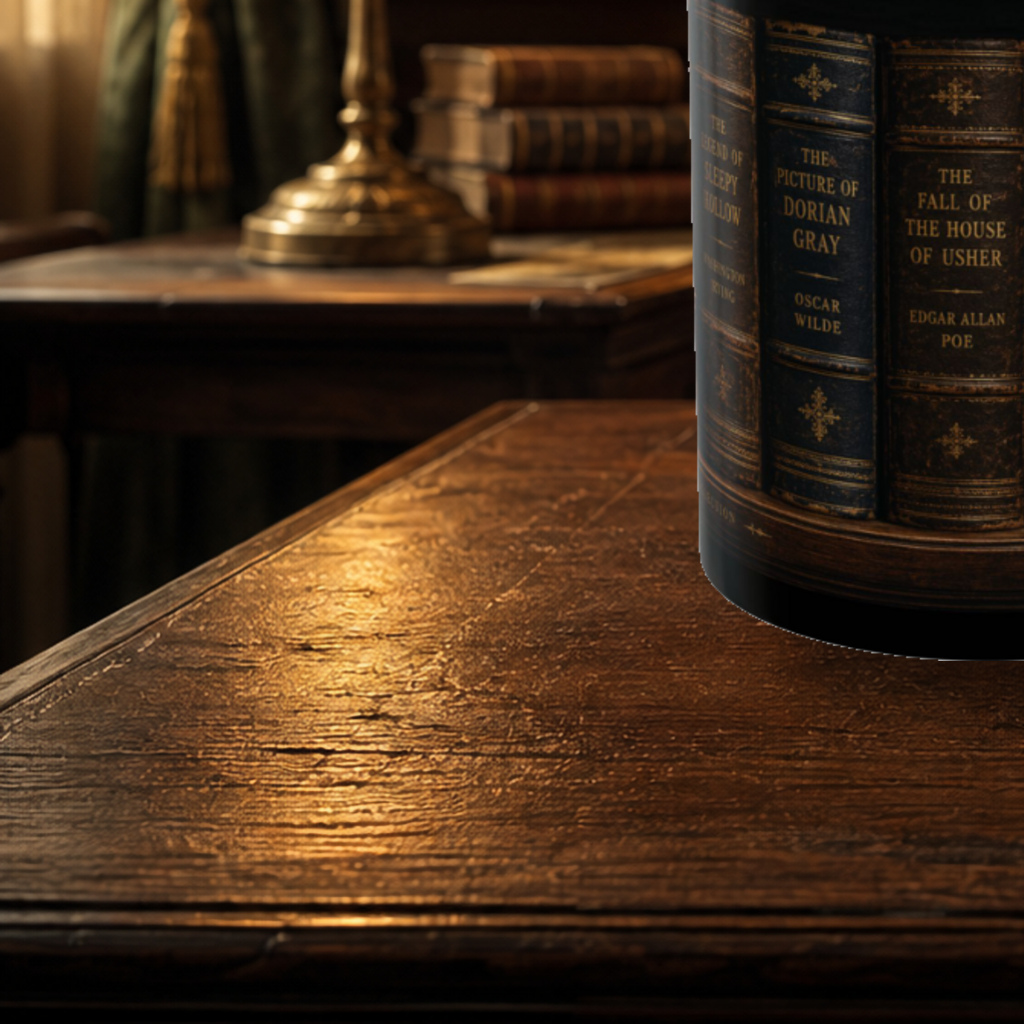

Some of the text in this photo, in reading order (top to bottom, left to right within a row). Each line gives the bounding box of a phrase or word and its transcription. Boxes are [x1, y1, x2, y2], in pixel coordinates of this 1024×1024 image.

[711, 114, 727, 135] THE
[731, 148, 744, 167] OF
[801, 147, 830, 167] THE
[704, 160, 738, 195] SLEEPY
[776, 167, 860, 198] PICTURE OF
[938, 167, 973, 185] THE
[703, 188, 742, 226] HOLLOW
[783, 195, 851, 227] DORIAN
[917, 192, 993, 211] FALL OF
[905, 218, 1007, 240] THE HOUSE
[792, 228, 841, 256] GRAY
[910, 246, 1003, 267] OF USHER
[703, 251, 746, 286] NGTON
[794, 292, 841, 314] OSCAR
[793, 312, 842, 335] WILDE
[909, 308, 1007, 326] EDGAR ALLAN
[941, 333, 974, 349] POE
